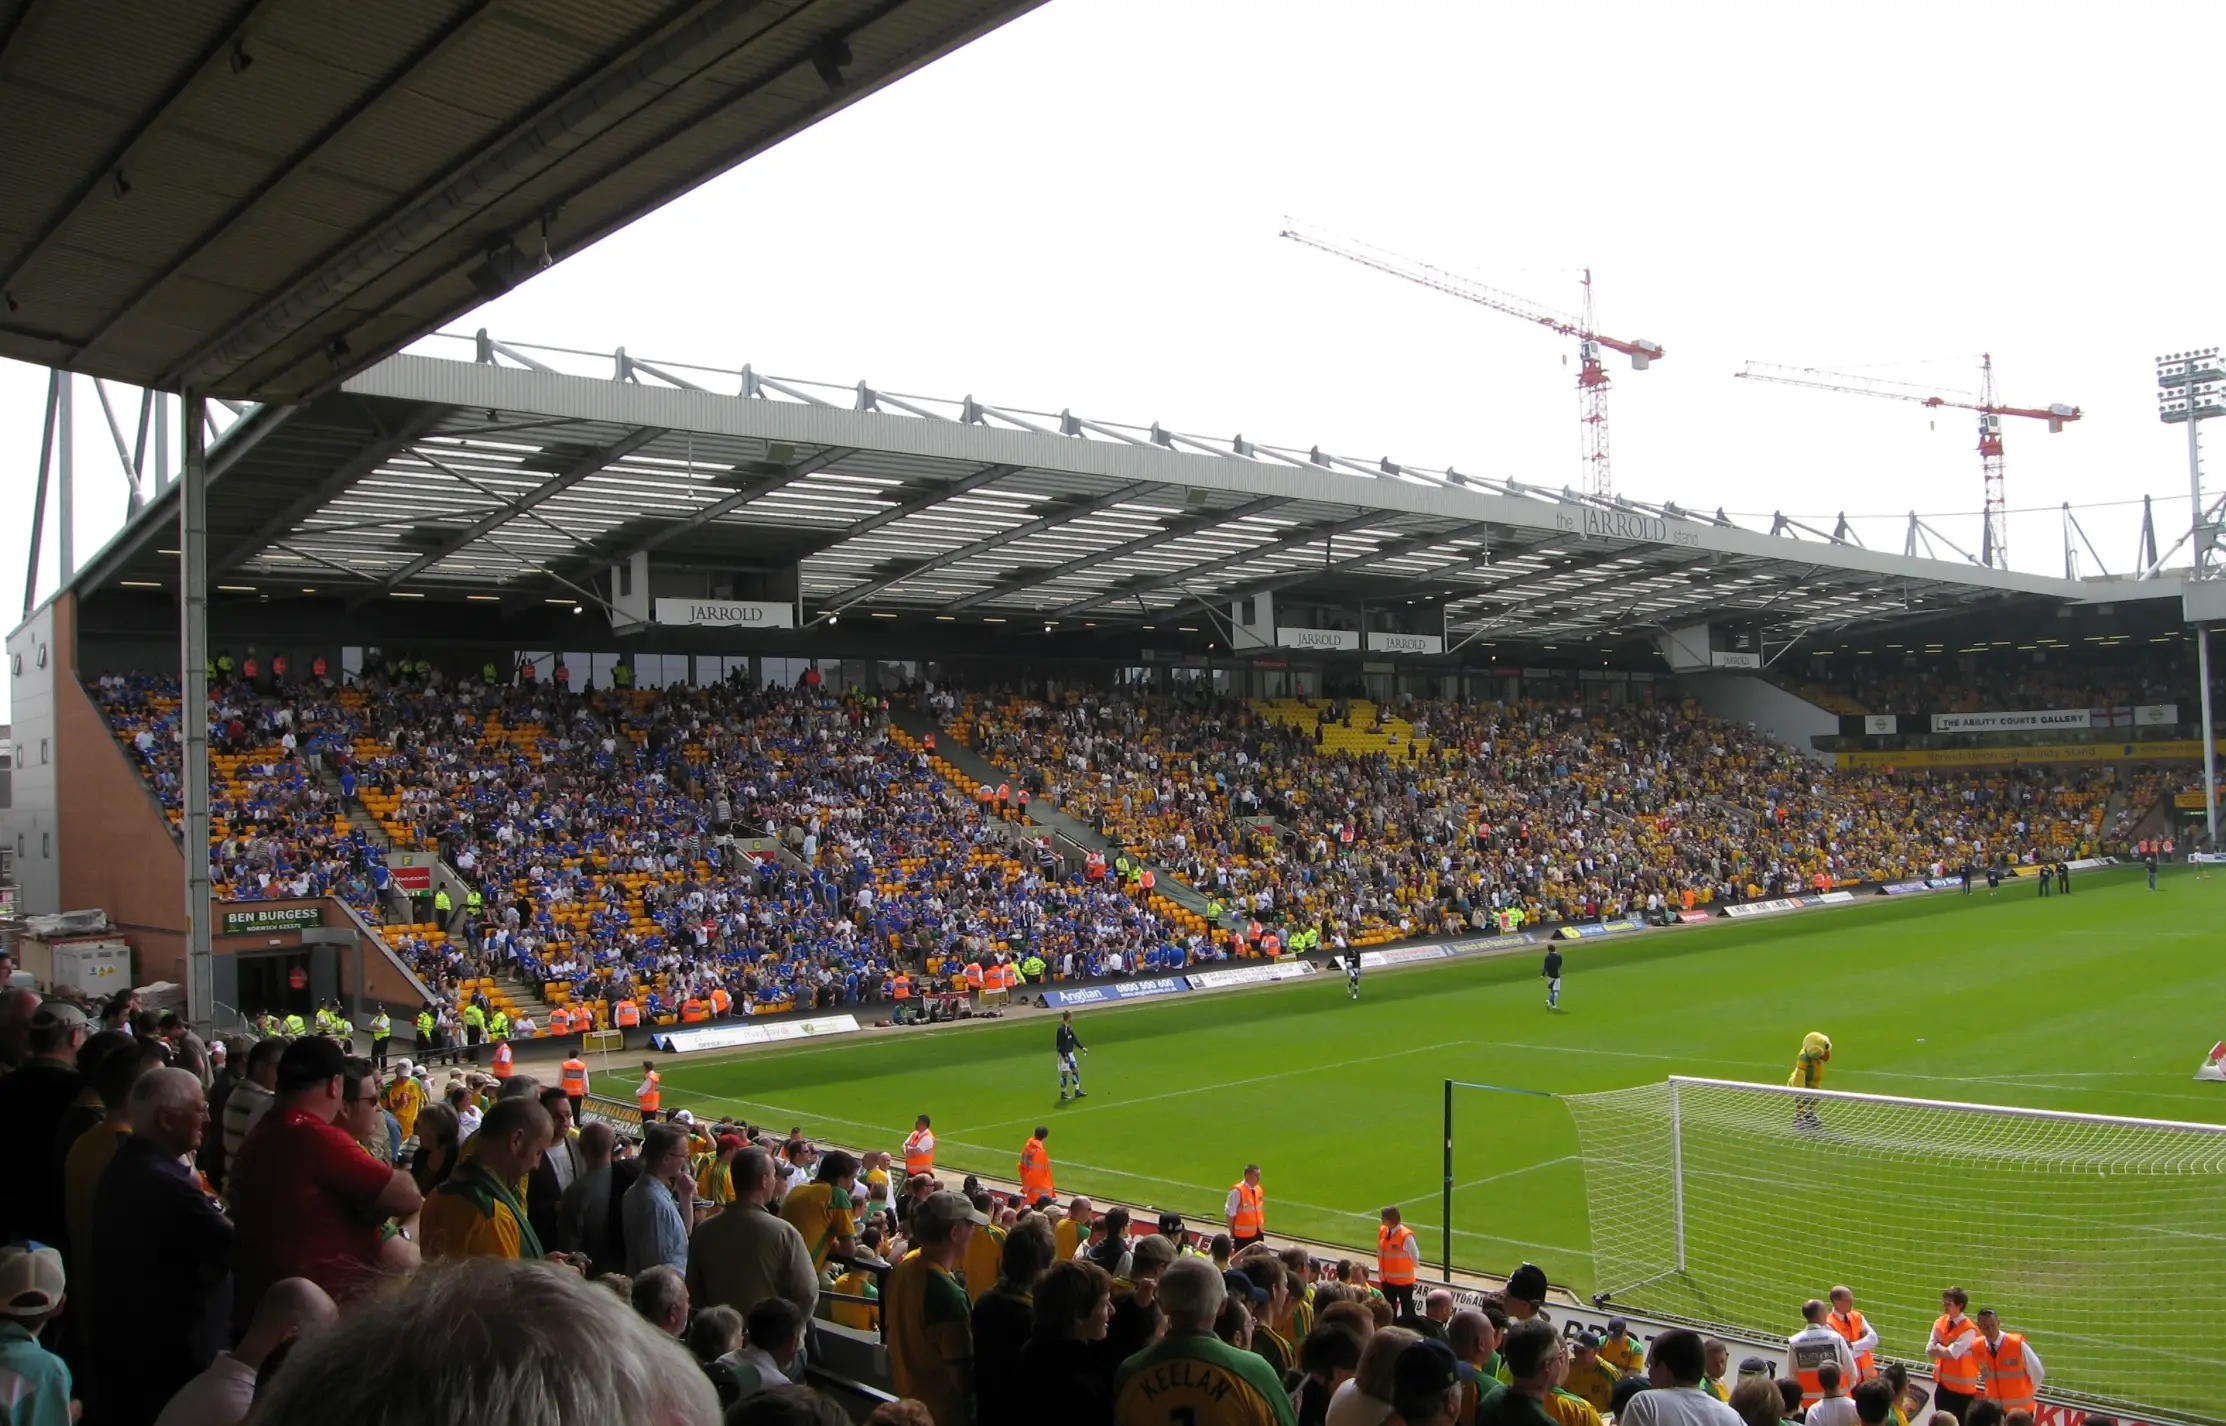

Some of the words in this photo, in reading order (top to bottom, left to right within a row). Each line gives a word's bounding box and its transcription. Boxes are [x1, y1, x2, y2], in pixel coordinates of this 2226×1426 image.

[1556, 512, 1574, 530] the
[1582, 508, 1666, 541] JARROLD
[1673, 530, 1698, 546] stand
[689, 605, 763, 623] JARROLD
[1297, 633, 1341, 647] JARROLD
[1386, 637, 1425, 650] JARROLD
[1943, 719, 1959, 727] THE
[1963, 717, 1997, 726] ABILITY
[2000, 716, 2037, 725] COUNTS
[2040, 714, 2083, 723] GALLERY
[2065, 746, 2096, 756] Stand
[403, 856, 411, 865] F
[229, 912, 254, 923] BEN
[258, 908, 318, 921] BURGESS
[1115, 982, 1139, 993] 0800
[1140, 980, 1156, 990] 500
[1157, 978, 1175, 988] 600
[1059, 988, 1103, 1002] Anglian
[1139, 1362, 1232, 1403] KEELAN
